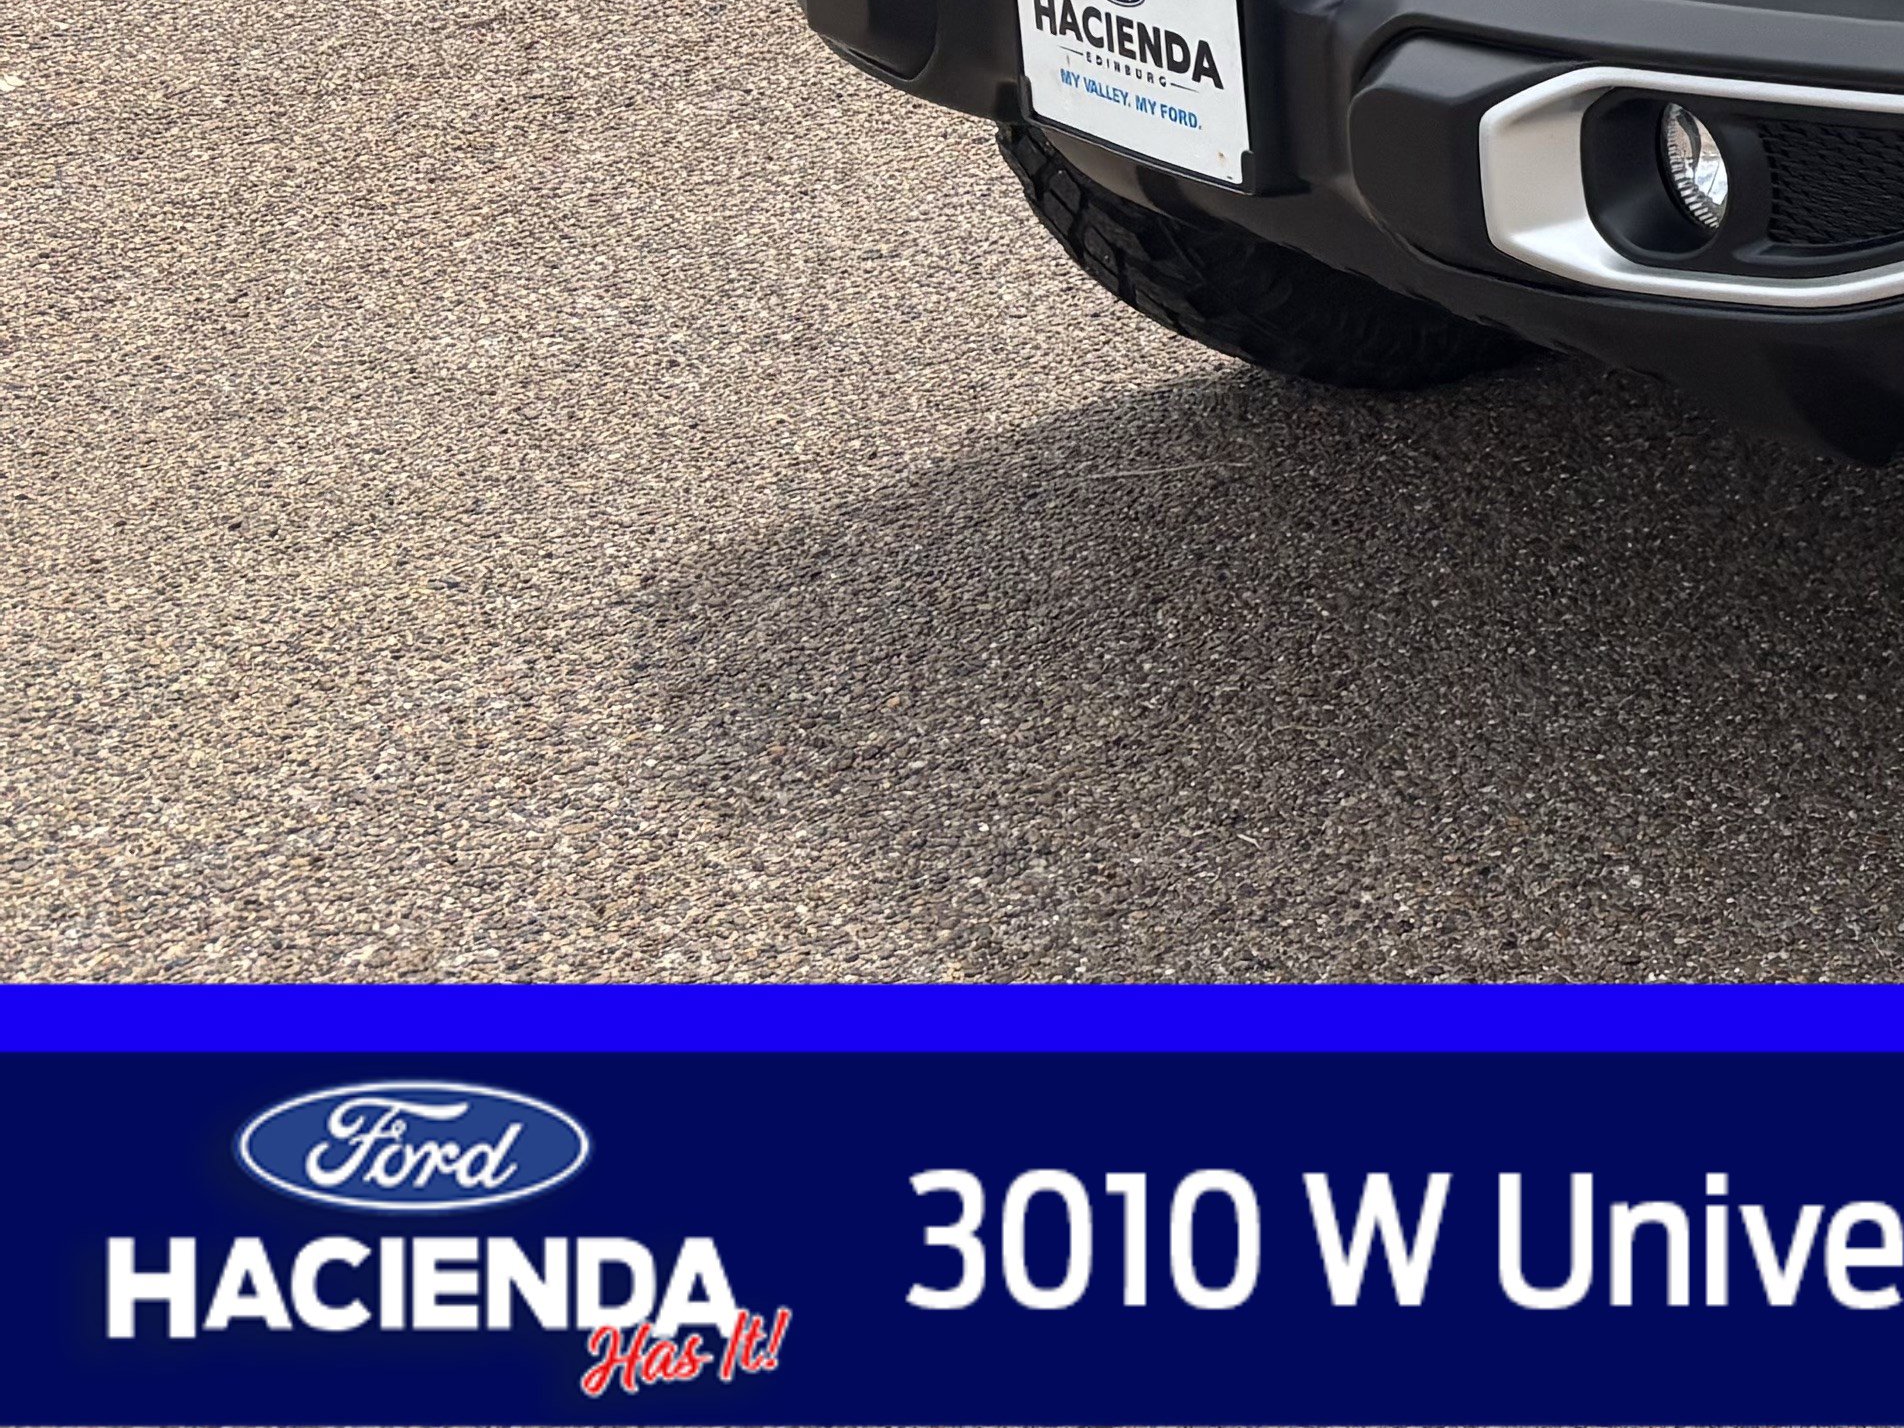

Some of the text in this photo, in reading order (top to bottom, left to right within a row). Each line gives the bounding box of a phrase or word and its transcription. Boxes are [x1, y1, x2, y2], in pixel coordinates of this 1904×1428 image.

[1086, 50, 1168, 88] EDINBURG
[1060, 67, 1203, 131] MY VALLEY. MY FORD.
